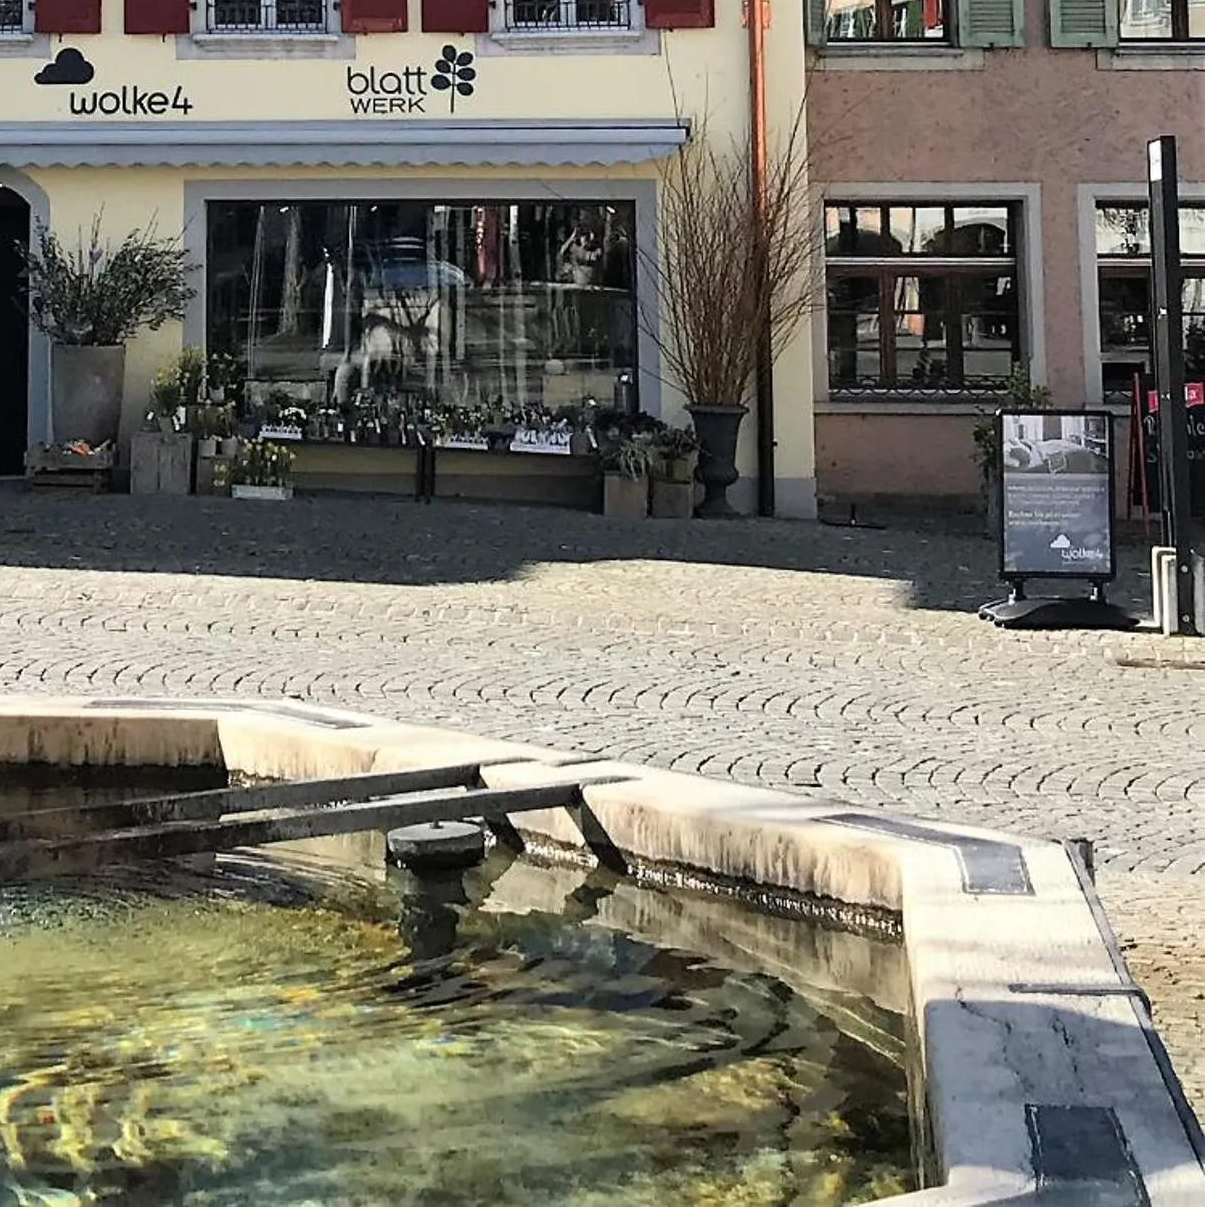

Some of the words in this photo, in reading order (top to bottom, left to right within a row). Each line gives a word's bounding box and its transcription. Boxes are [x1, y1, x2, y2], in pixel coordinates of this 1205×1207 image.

[347, 66, 427, 96] blatt
[70, 85, 193, 115] wolke4
[350, 97, 426, 114] WERK
